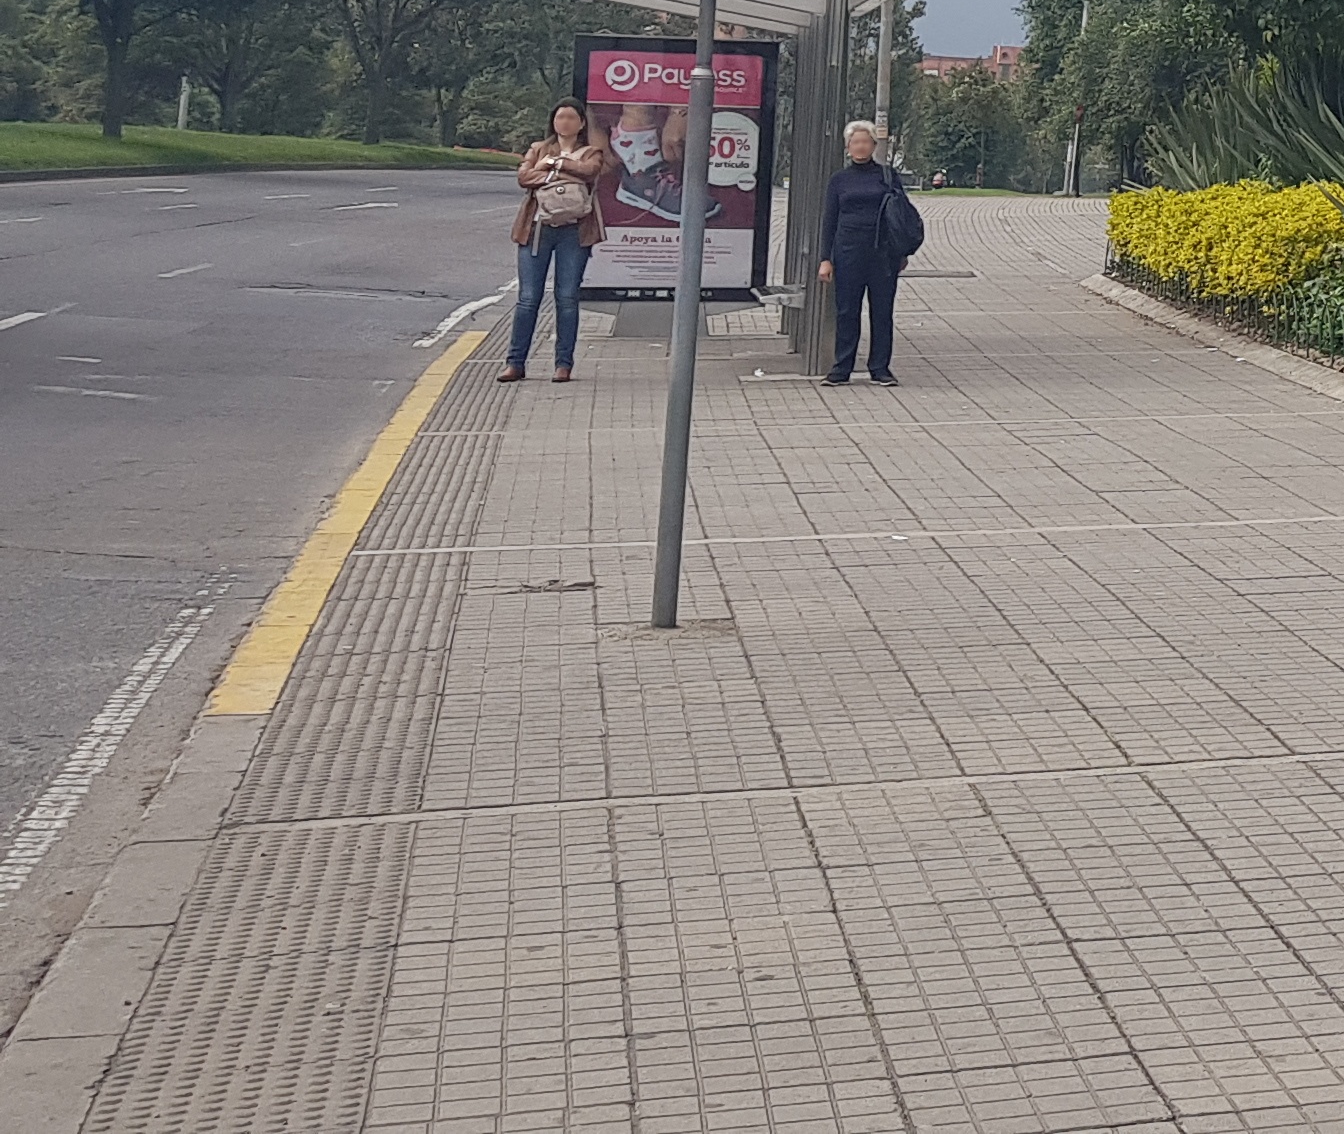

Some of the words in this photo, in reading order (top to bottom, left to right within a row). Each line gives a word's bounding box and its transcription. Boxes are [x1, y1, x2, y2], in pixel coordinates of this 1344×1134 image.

[643, 63, 746, 90] Payss
[620, 234, 658, 245] Apoya
[660, 234, 674, 244] la
